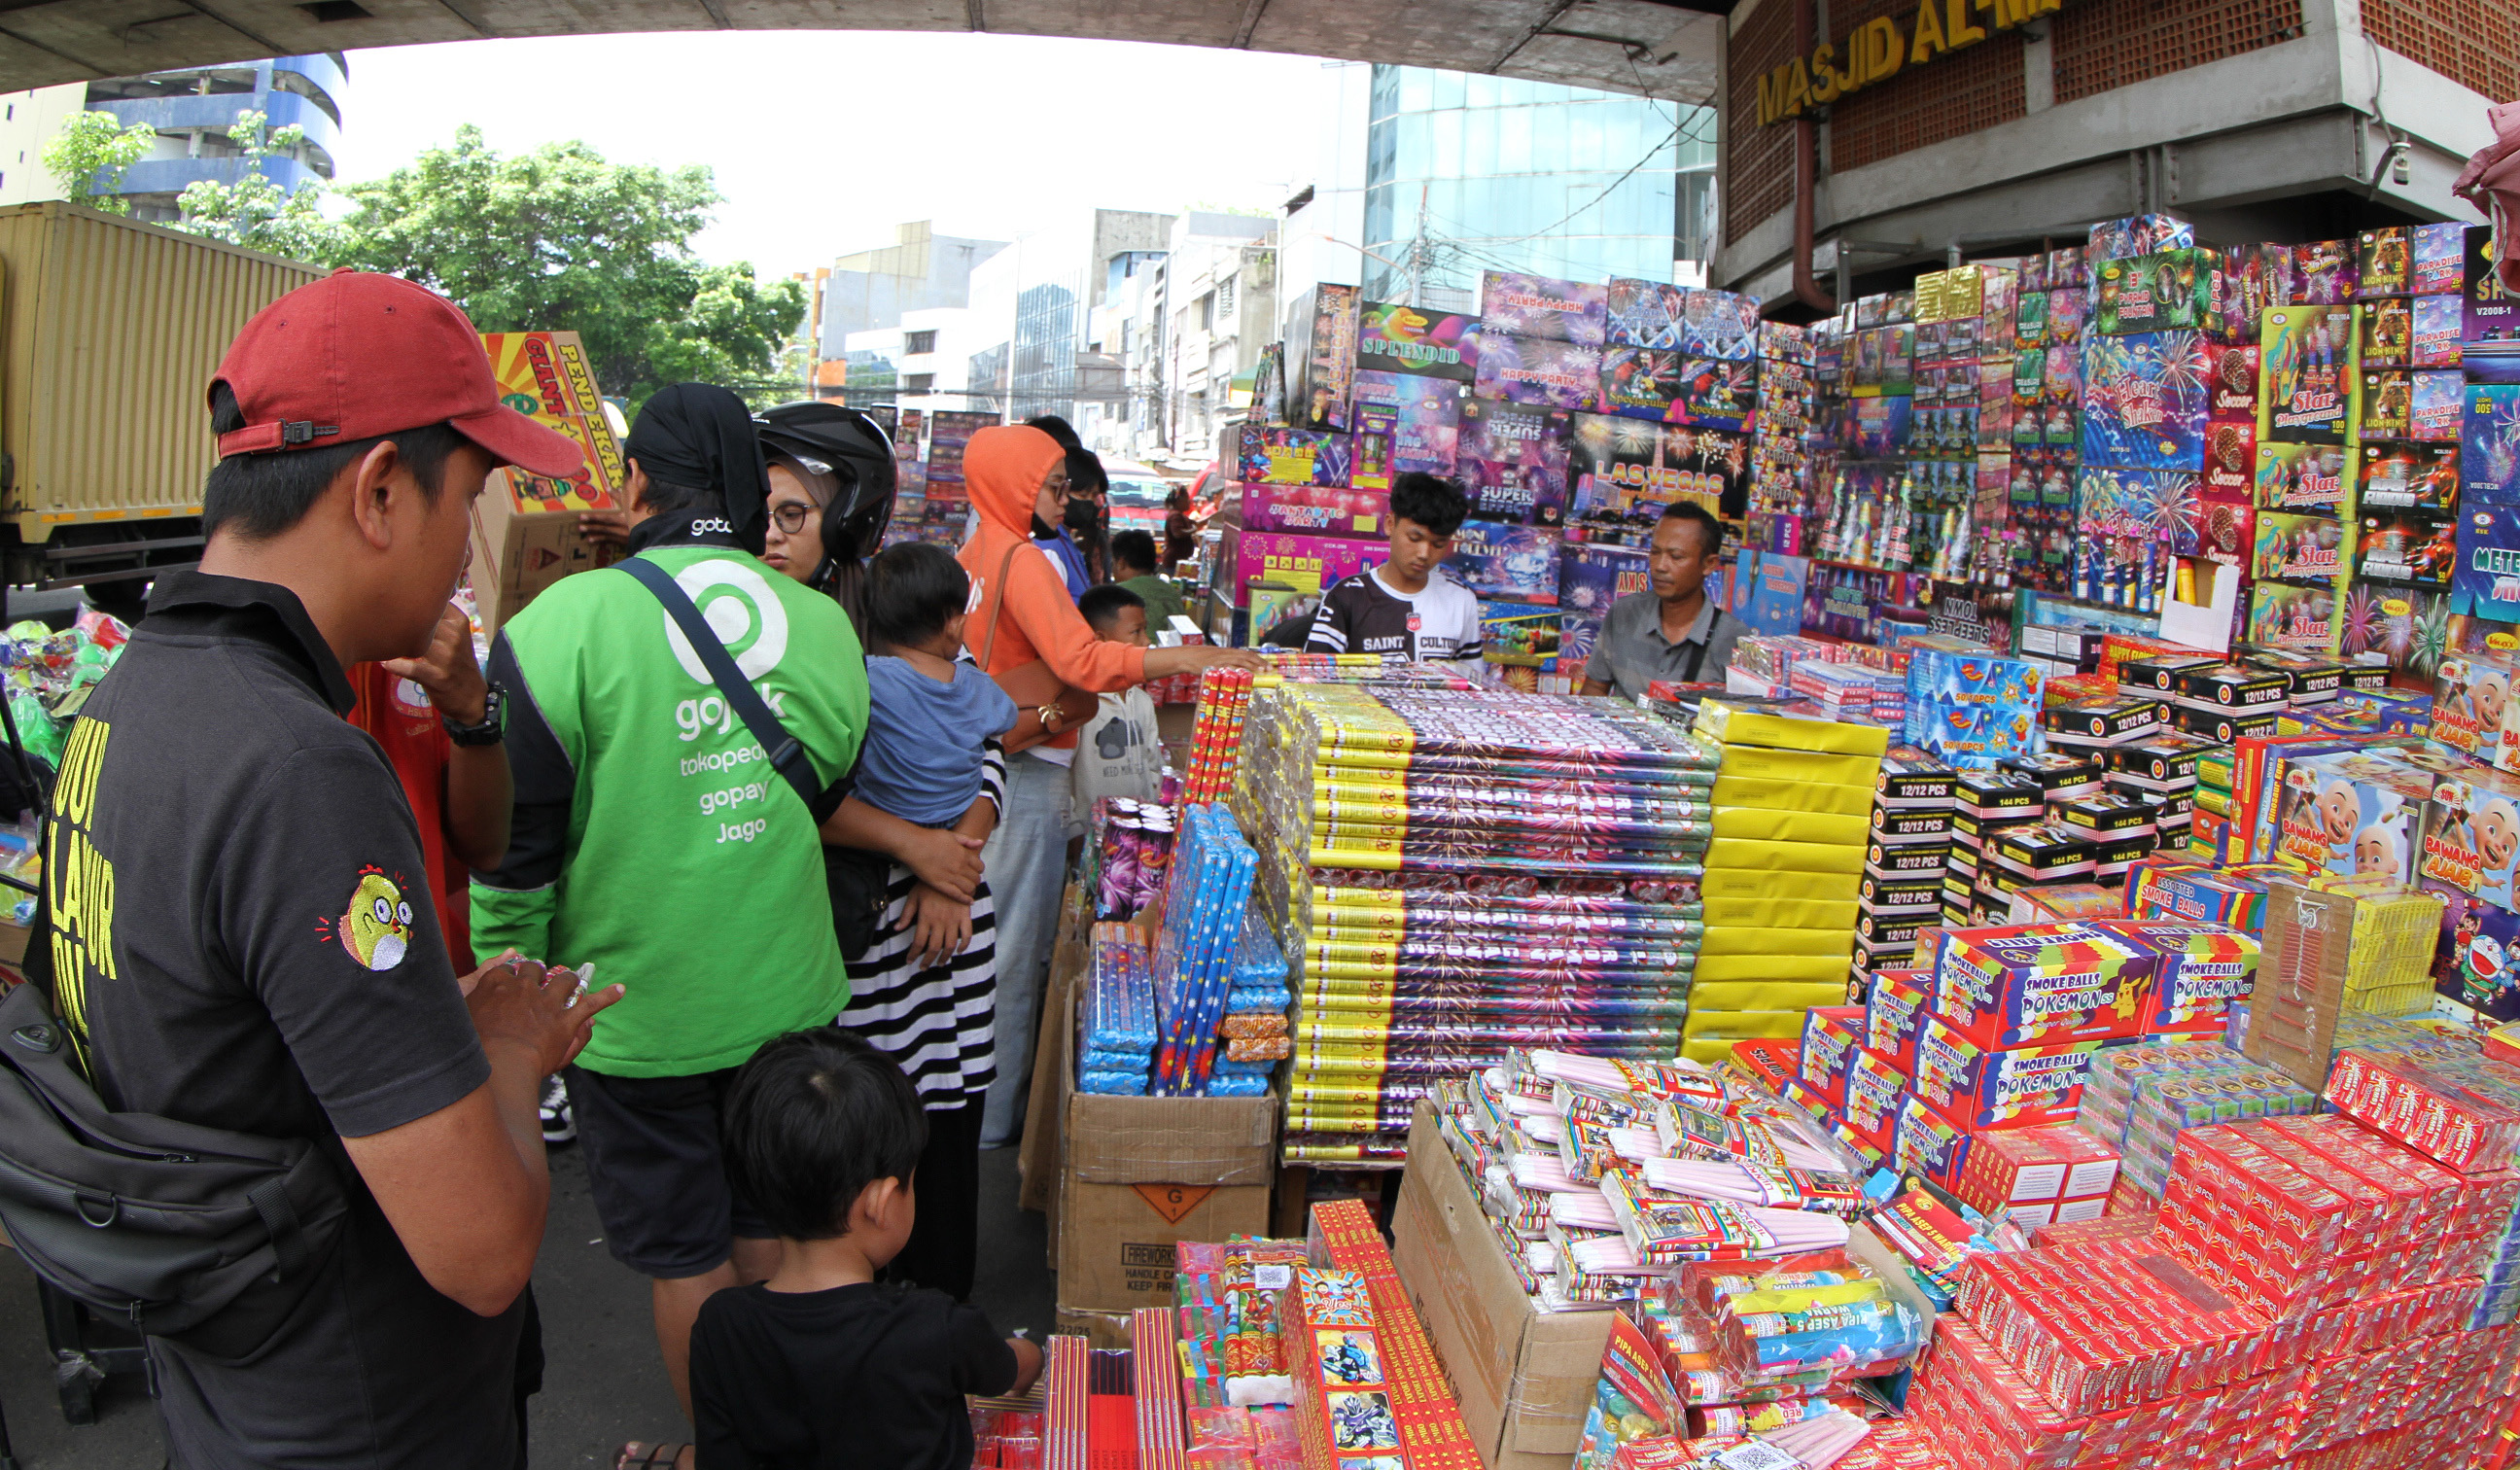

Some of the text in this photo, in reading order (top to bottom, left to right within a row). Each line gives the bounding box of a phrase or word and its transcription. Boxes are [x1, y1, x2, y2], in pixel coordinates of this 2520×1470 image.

[1758, 16, 1905, 127] MASJID
[2416, 254, 2464, 273] PARADISE
[2362, 273, 2405, 285] LION KING
[2427, 267, 2453, 283] PARK
[1508, 294, 1584, 314] HAPPY PARTY
[2118, 303, 2154, 320] FOUNTAIN
[2476, 305, 2512, 317] V2008-1
[2415, 329, 2461, 345] PARADISE
[1362, 337, 1461, 365] SPLENDID
[2364, 345, 2406, 357] LION KING
[2424, 340, 2451, 355] PARK
[525, 337, 569, 417] GIANT
[1500, 368, 1579, 387] HAPPY PARTY
[2115, 375, 2161, 406] Heart
[2217, 389, 2254, 409] Soccer
[2292, 392, 2335, 413] Star
[2415, 403, 2461, 419] PARADISE
[2475, 404, 2492, 414] 300
[2120, 401, 2164, 430] Shaken
[2275, 405, 2343, 428] Playground
[2331, 420, 2345, 430] 100
[2365, 417, 2407, 429] LION KING
[2424, 414, 2450, 429] PARK
[1488, 424, 1542, 441] SUPER
[1596, 460, 1725, 496] LAS VEGAS
[2208, 468, 2245, 487] Soccer
[2300, 473, 2339, 492] Star
[1480, 485, 1534, 503] SUPER
[2284, 490, 2347, 507] Playground
[2106, 510, 2152, 541] Heart
[2298, 545, 2337, 565] Star
[2284, 562, 2343, 577] Playground
[1944, 597, 1978, 618] TOWN
[2292, 616, 2329, 636] Star
[1363, 636, 1406, 650] SAINT
[2306, 676, 2339, 690] 12/12 PCS
[2354, 676, 2384, 688] 12/12 PCS
[1955, 692, 1998, 705] 50/10PCS
[2245, 688, 2281, 703] 12/12 PCS
[676, 682, 787, 742] gojk
[2432, 706, 2479, 734] BAWANG
[2433, 724, 2473, 749] AJAIB
[1943, 741, 1985, 752] 50/10PCS
[681, 741, 768, 777] tokoped
[2058, 778, 2072, 787] 144
[699, 780, 769, 816] gopay
[2014, 796, 2030, 805] PCS
[716, 818, 766, 844] Jago
[2282, 819, 2328, 847] BAWANG
[2285, 834, 2323, 863] AJAIB
[2425, 835, 2480, 872] BAWANG
[2051, 854, 2082, 865] 144 PCS
[2426, 854, 2474, 884] AJAIB
[2156, 876, 2194, 897] ASSORTED
[2141, 885, 2206, 919] SMOKE BALLS
[1983, 929, 2105, 948] SMOKE BALLS
[2180, 962, 2243, 975] SMOKE BALLS
[1942, 961, 1985, 1001] POKEMON
[2025, 972, 2101, 993] SMOKE BALLS
[2175, 980, 2241, 999] POKEMON
[2021, 990, 2102, 1015] POKEMON
[1872, 998, 1908, 1032] POKEMON
[1949, 1000, 1973, 1027] 12/6
[1878, 1033, 1898, 1056] 12/6
[1811, 1068, 1829, 1090] 12/6
[1996, 1070, 2076, 1096] POKEMON
[1929, 1082, 1950, 1108] 12/6
[2178, 1141, 2195, 1157] 20 PCS
[2202, 1159, 2221, 1175] 20 PCS
[1168, 1189, 1183, 1205] G
[1896, 1202, 1915, 1221] PIPA
[1910, 1214, 1933, 1234] ASEP
[1931, 1231, 1962, 1258] WARNA
[1126, 1269, 1161, 1280] HANDLE
[1775, 1273, 1815, 1281] ORANGE
[1127, 1280, 1153, 1291] KEEP
[1805, 1305, 1851, 1316] WARNA
[1805, 1316, 1839, 1332] ASEP
[1614, 1335, 1632, 1357] PIPA
[1631, 1350, 1651, 1372] ASEP
[1783, 1408, 1802, 1418] RED
